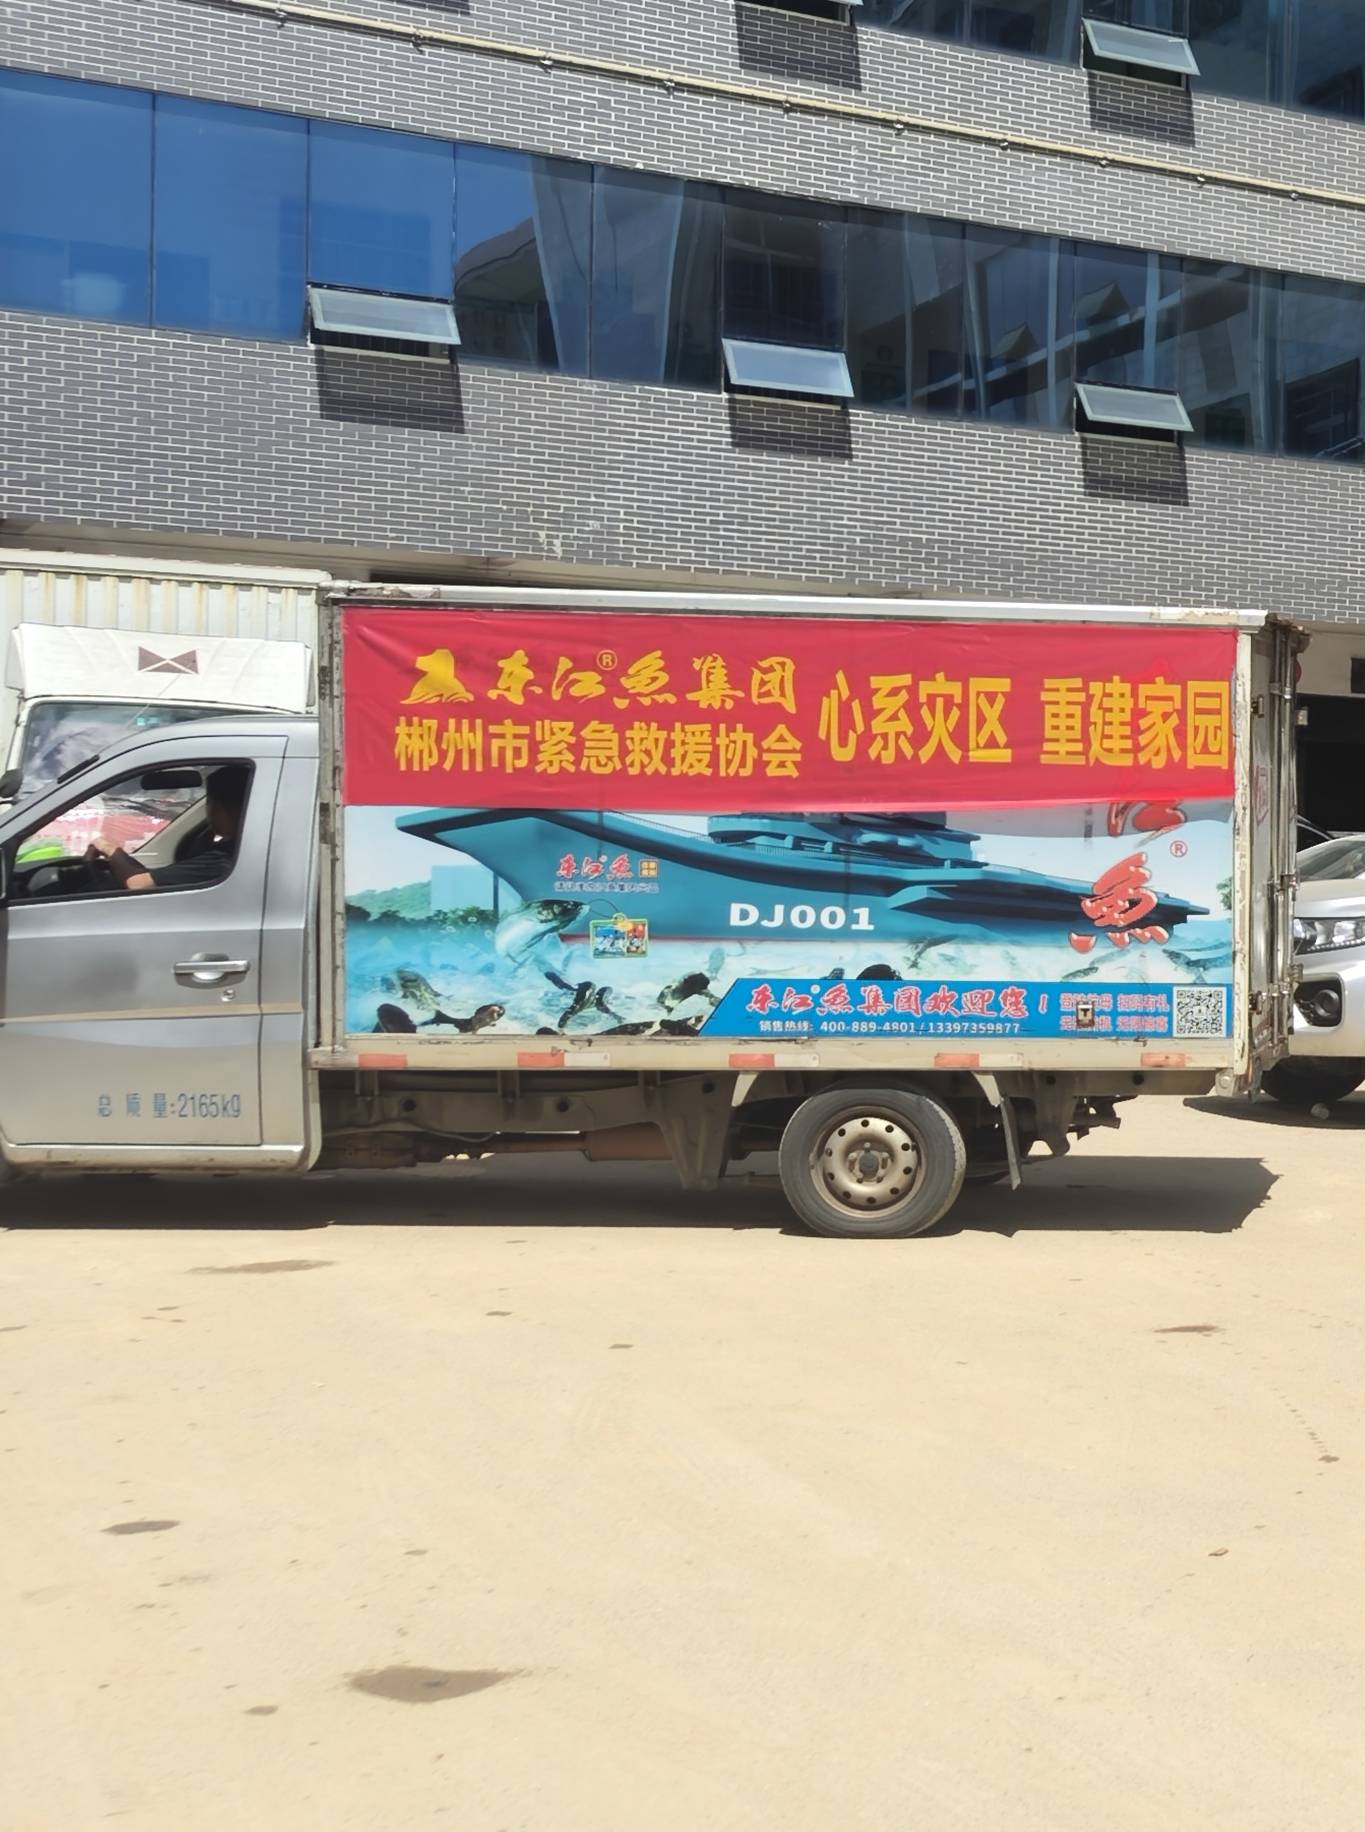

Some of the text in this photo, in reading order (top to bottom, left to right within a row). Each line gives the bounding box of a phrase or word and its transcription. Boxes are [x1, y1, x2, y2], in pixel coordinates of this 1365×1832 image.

[394, 715, 803, 780] 郴州市紧急救援协会
[817, 669, 1230, 770] 心系灾区 重建家园
[729, 903, 875, 932] DJ001
